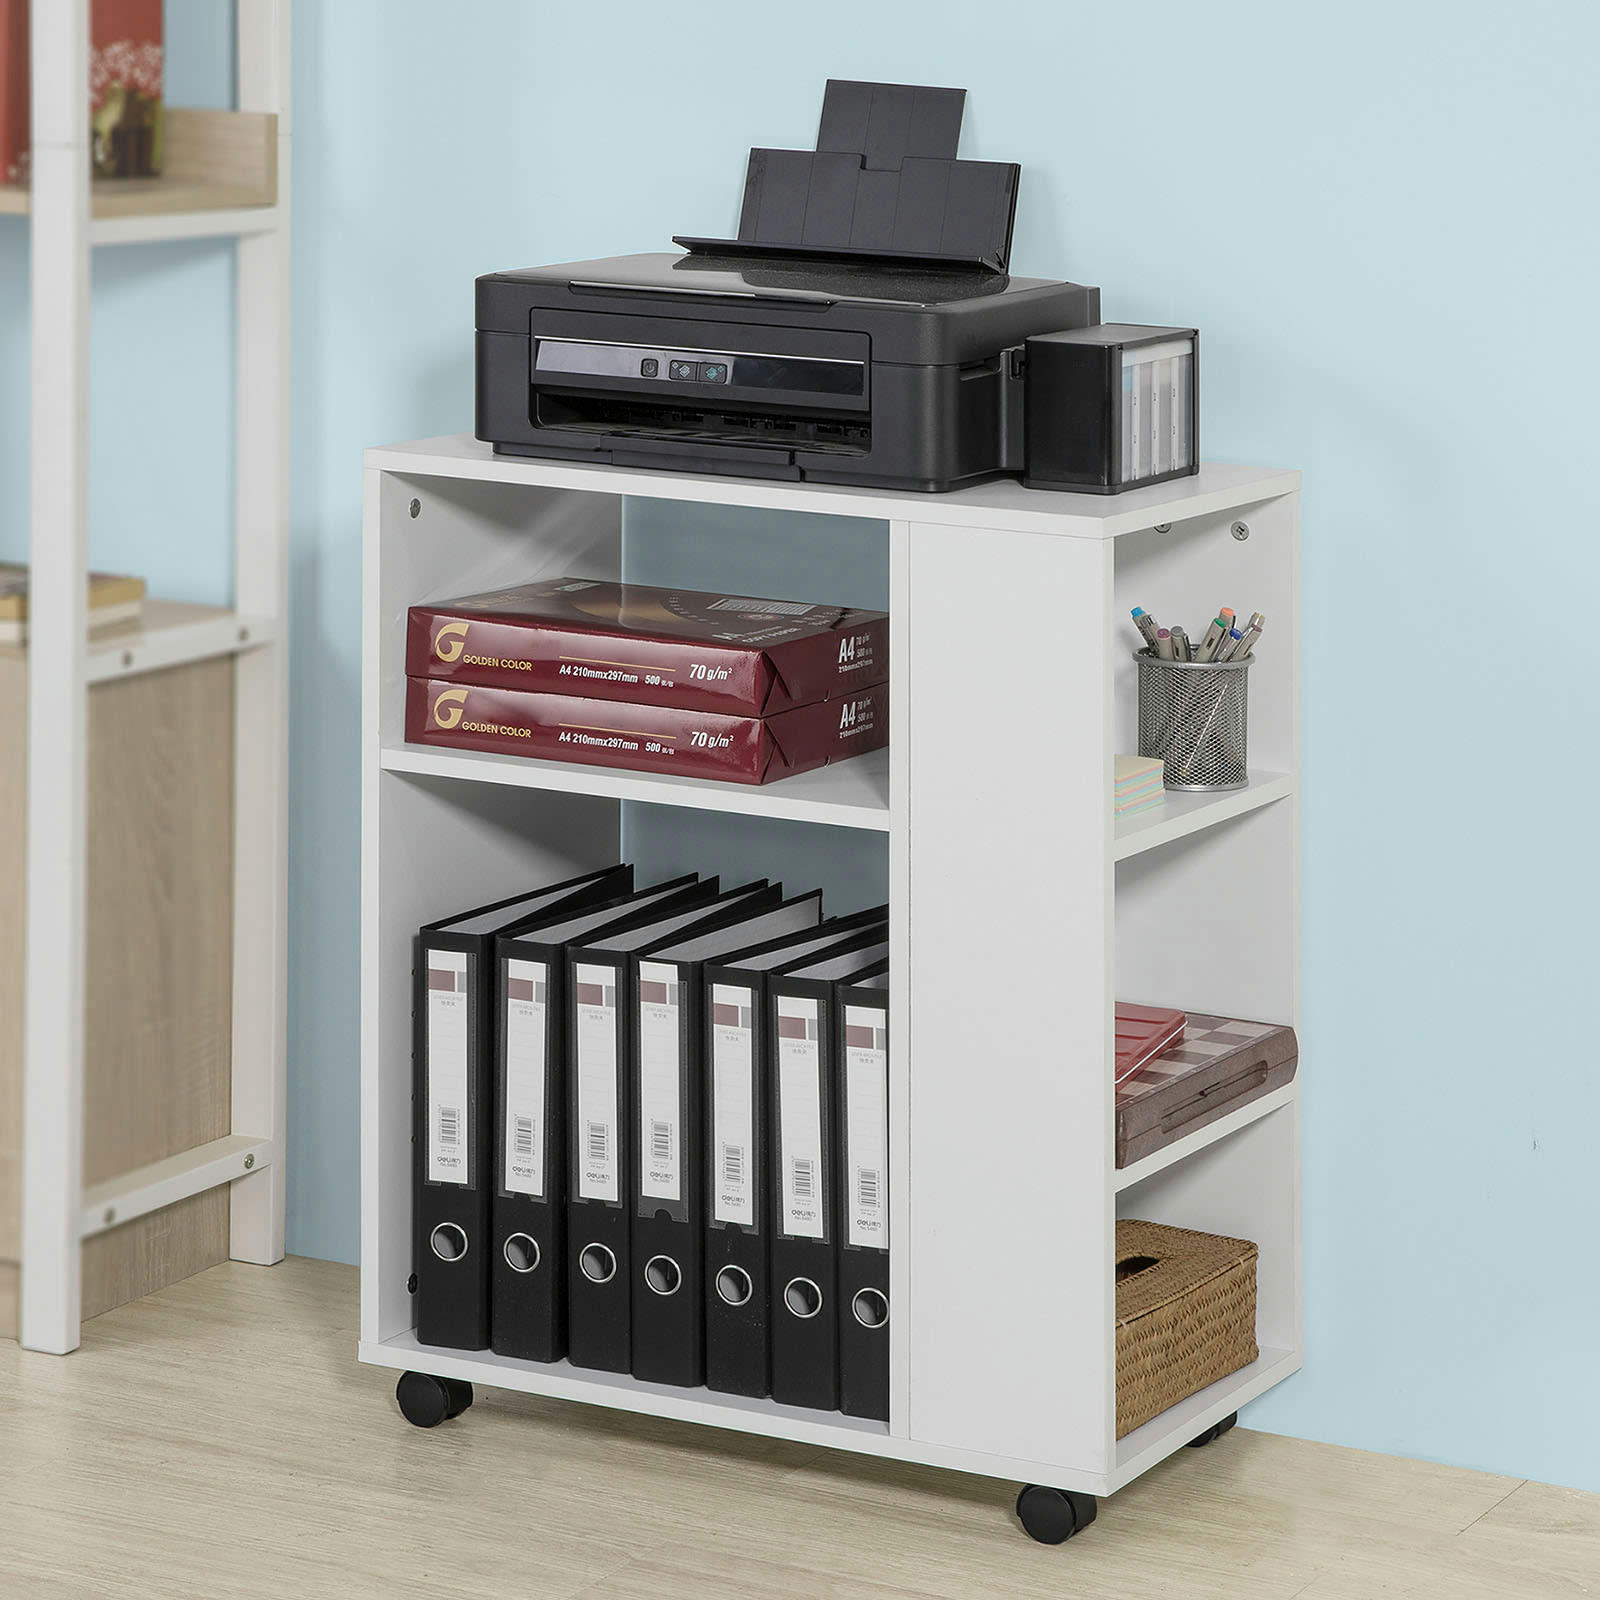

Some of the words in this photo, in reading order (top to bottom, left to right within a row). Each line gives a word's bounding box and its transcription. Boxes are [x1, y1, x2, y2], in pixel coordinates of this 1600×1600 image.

[838, 636, 855, 663] A4
[462, 654, 499, 667] GOLDEN
[500, 658, 532, 671] COLOR
[689, 664, 706, 680] 70
[559, 664, 571, 675] A4
[573, 666, 638, 683] 210mmx297mm
[645, 674, 660, 685] 500
[840, 701, 856, 729] A4
[461, 721, 498, 734] GOLDEN
[499, 725, 532, 738] COLOR
[558, 732, 571, 742] A4
[573, 733, 638, 751] 210mmx297mm
[645, 742, 661, 753] 500
[690, 732, 707, 747] 70
